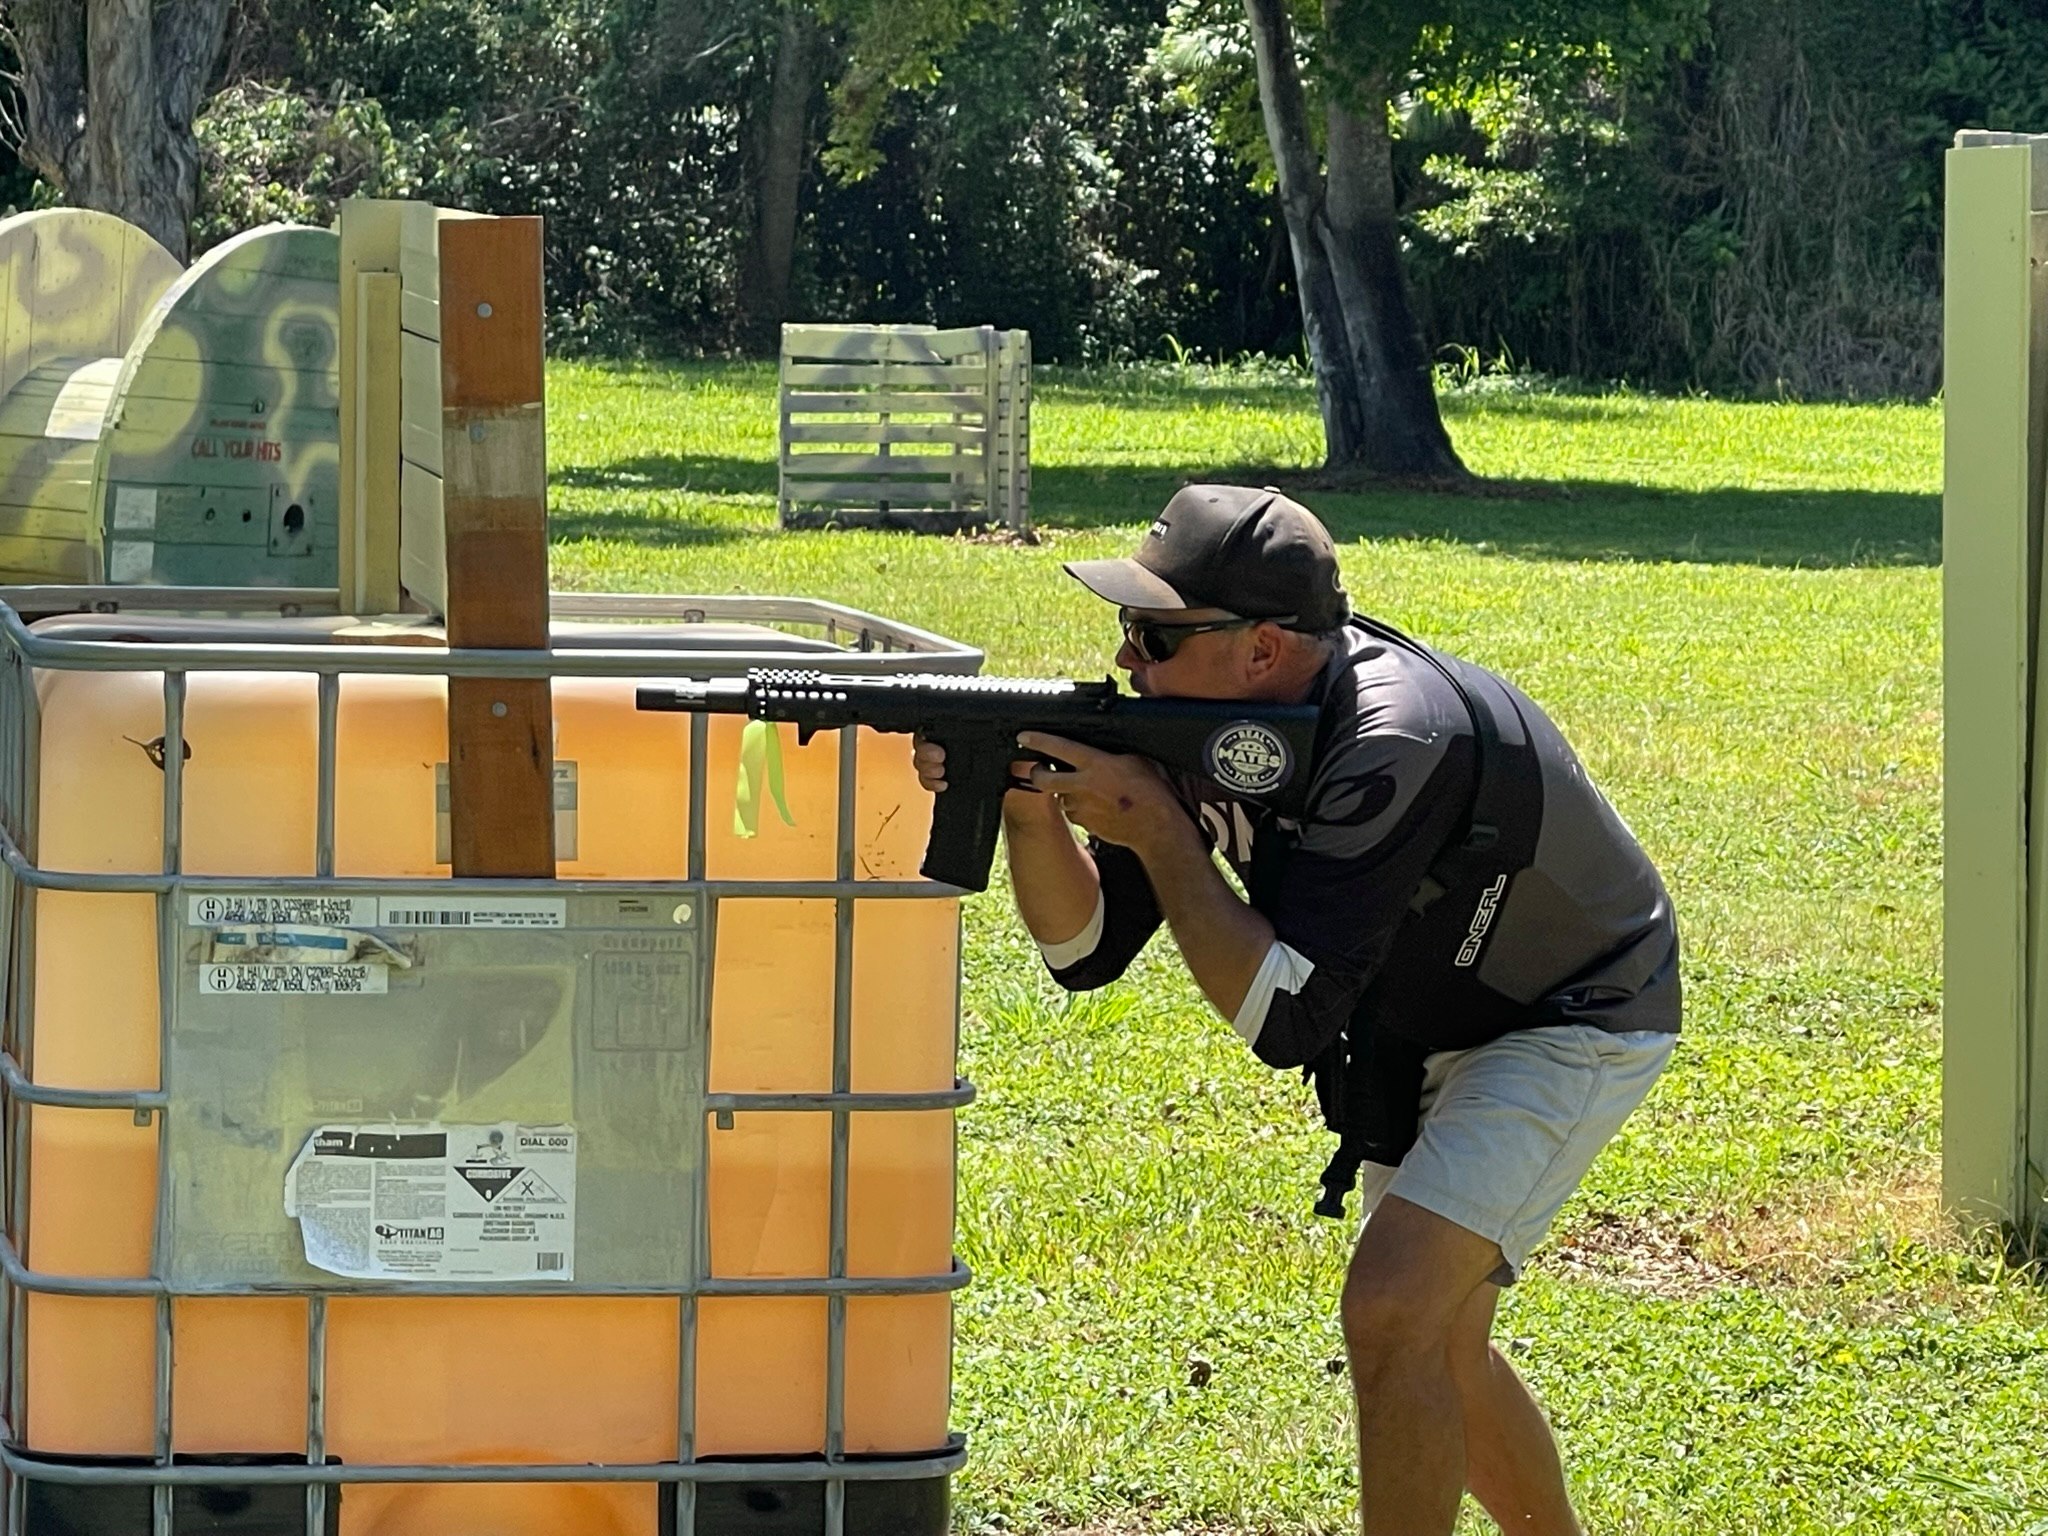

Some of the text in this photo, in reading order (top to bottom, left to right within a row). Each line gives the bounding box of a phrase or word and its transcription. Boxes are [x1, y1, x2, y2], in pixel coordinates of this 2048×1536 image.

[191, 439, 282, 462] CALL YOUR HITS
[1238, 730, 1266, 742] REAL
[1218, 747, 1280, 767] MATES
[1234, 771, 1260, 783] TALK
[520, 1137, 568, 1146] DIAL 000
[399, 1228, 426, 1238] TITAN
